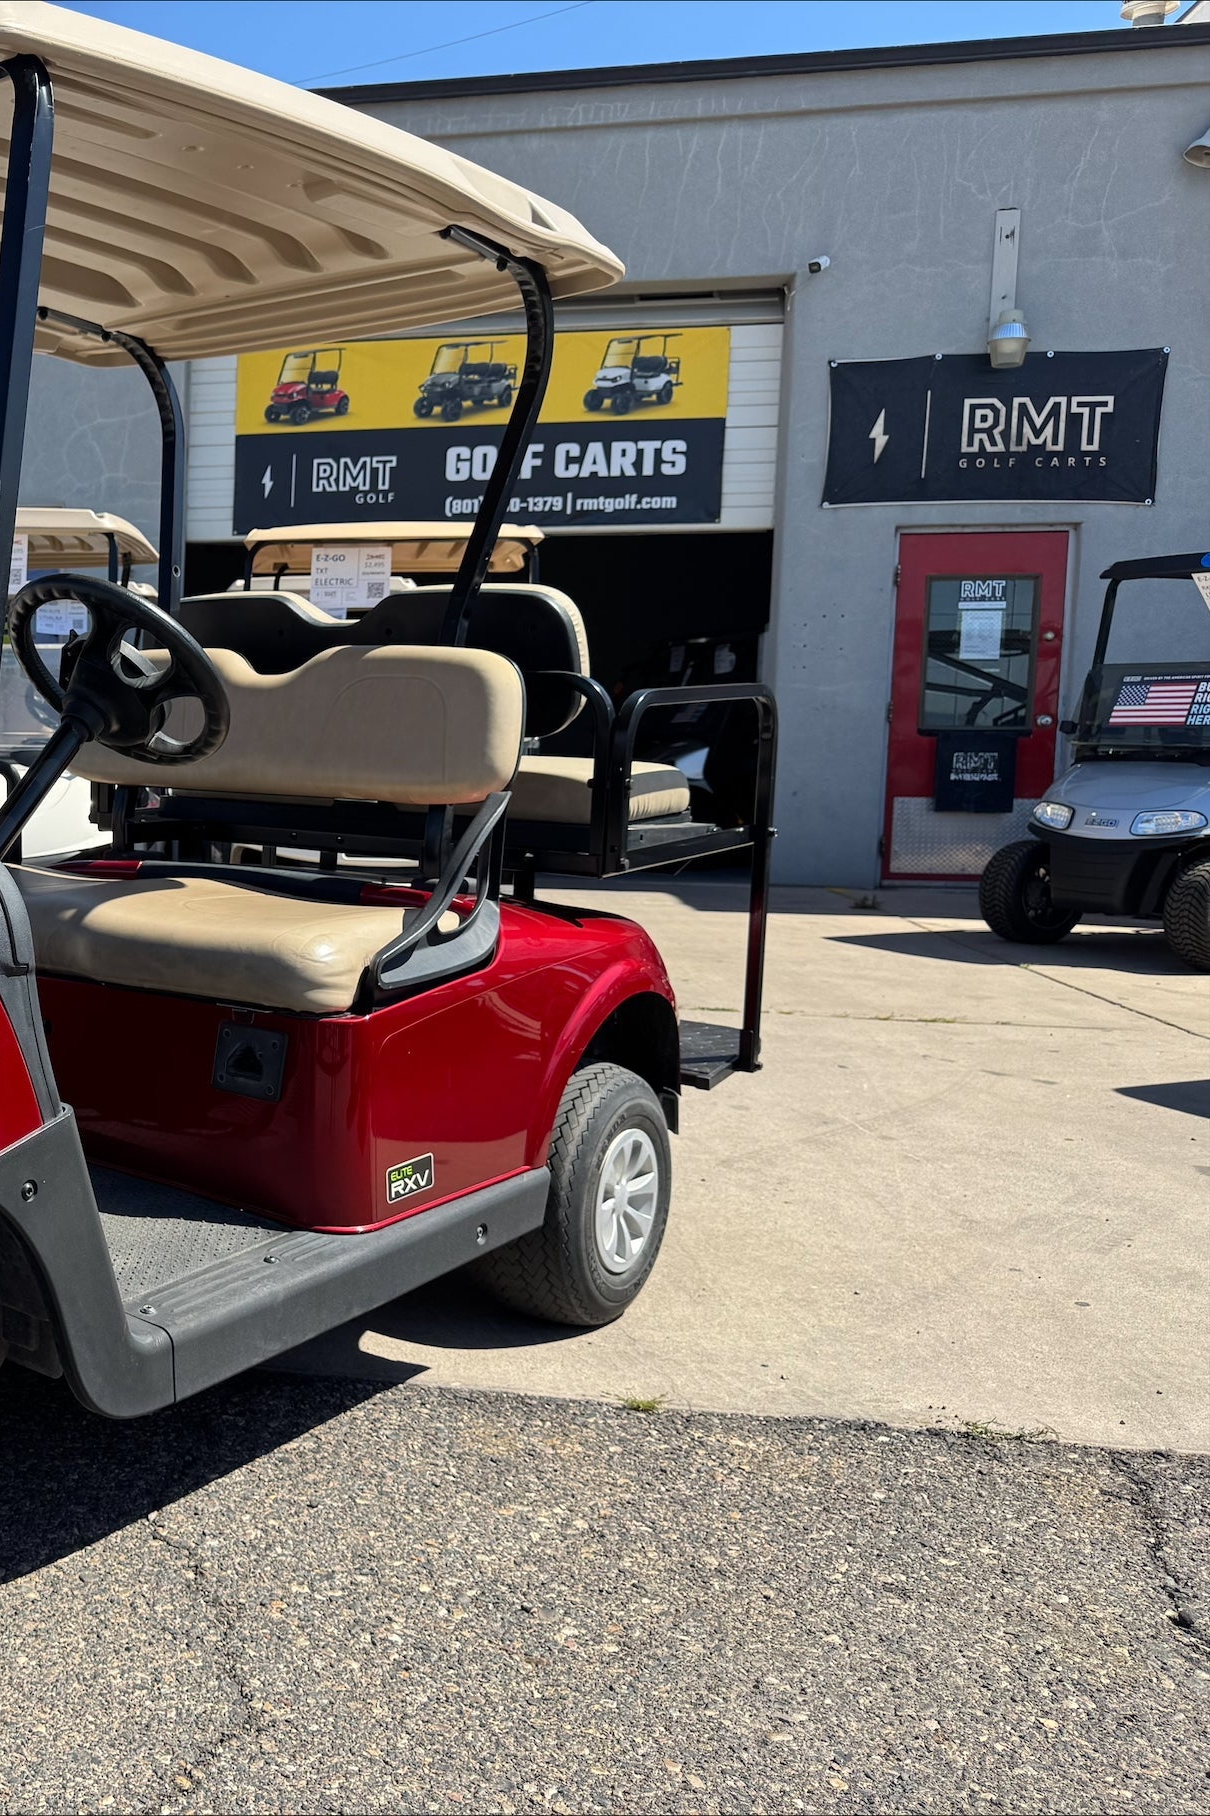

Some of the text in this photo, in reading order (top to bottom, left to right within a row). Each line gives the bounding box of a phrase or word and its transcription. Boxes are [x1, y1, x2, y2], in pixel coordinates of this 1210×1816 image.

[961, 395, 1115, 453] RMT
[312, 439, 687, 493] RMT GOF CARTS
[958, 456, 1107, 469] GOLF CARTS
[355, 492, 395, 505] GOLF
[576, 493, 677, 514] rmtgolf.com
[315, 554, 346, 562] E-Z-GO
[314, 578, 354, 586] ELECTRIC
[960, 580, 1006, 598] RMT
[390, 1165, 413, 1182] ELITE
[390, 1169, 430, 1198] RXV
